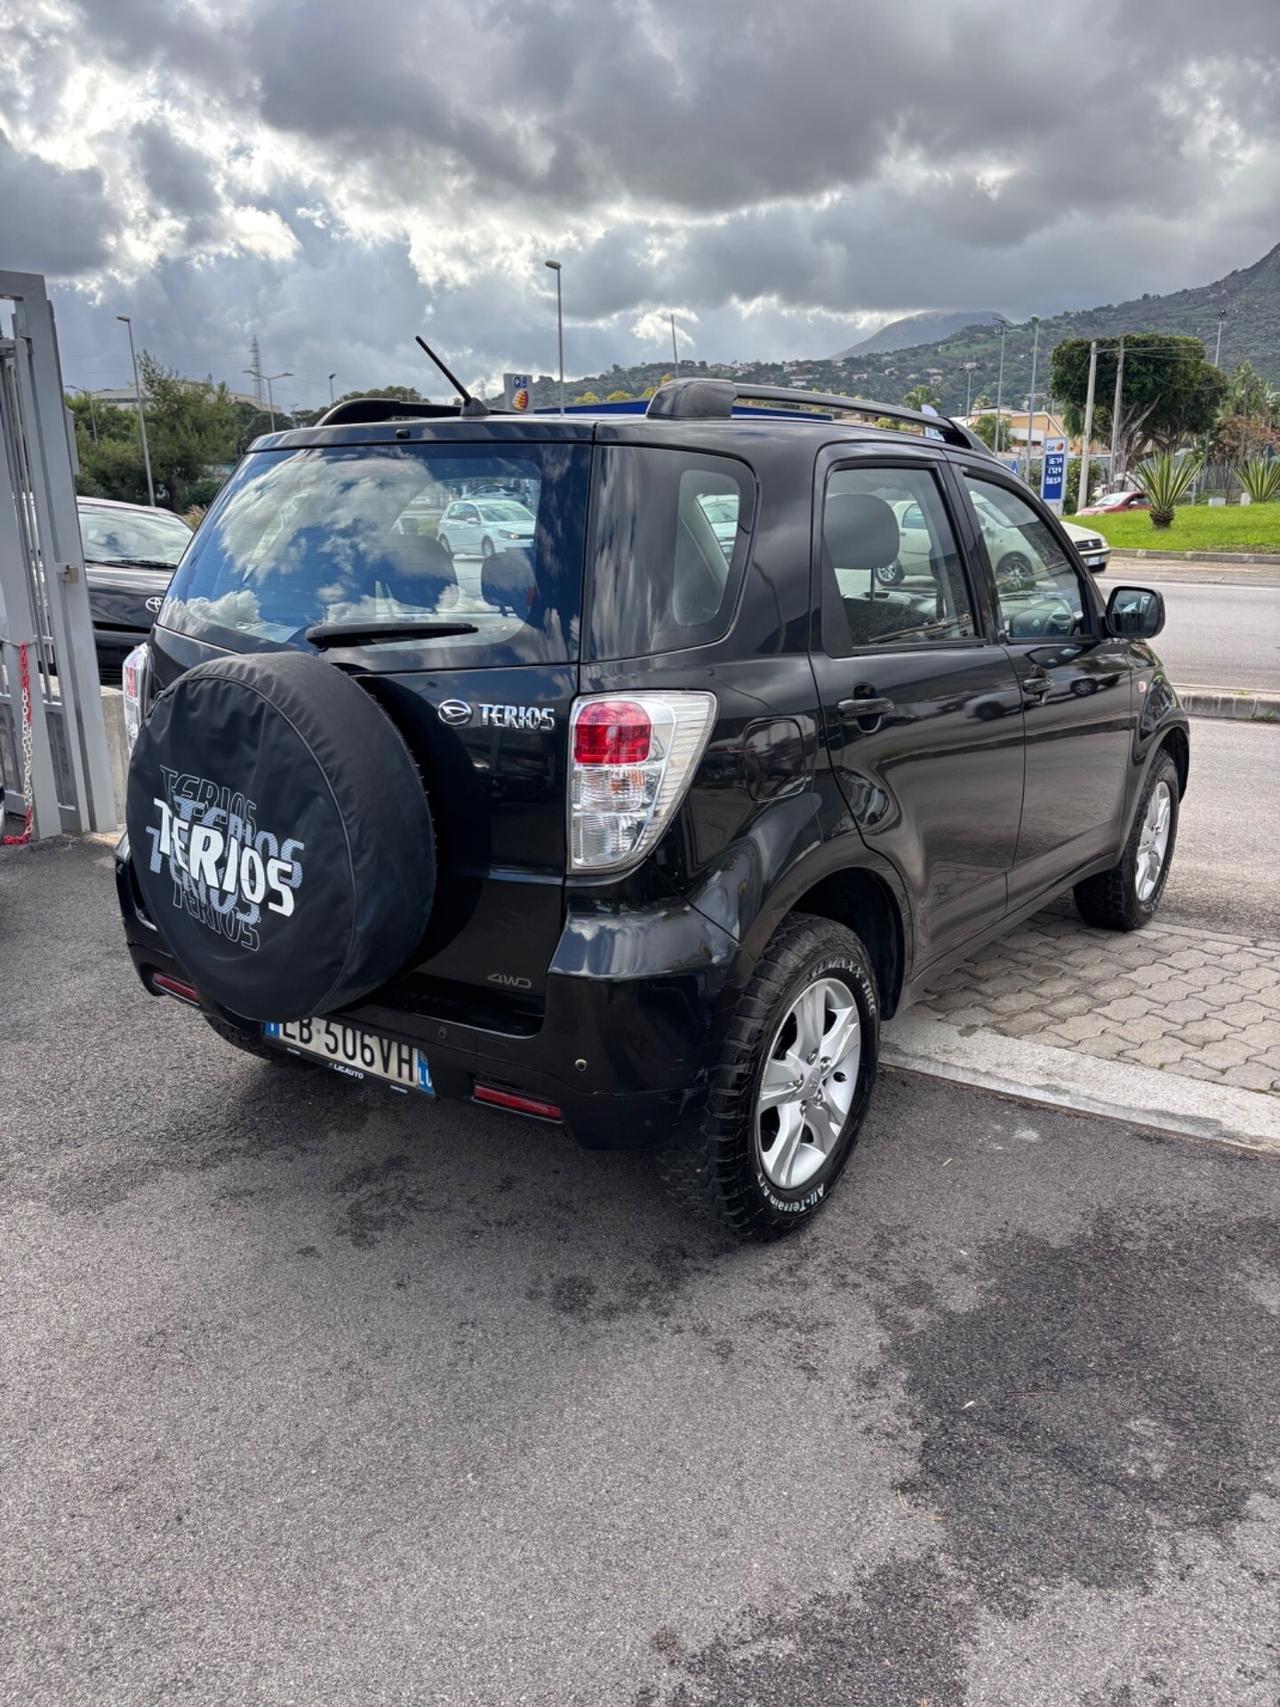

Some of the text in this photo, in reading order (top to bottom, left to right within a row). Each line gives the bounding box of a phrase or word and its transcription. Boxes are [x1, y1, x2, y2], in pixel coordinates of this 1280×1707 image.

[514, 376, 528, 388] Q8
[478, 703, 555, 731] TERIOS
[153, 797, 295, 918] TERIOS
[487, 972, 532, 989] 4WD
[770, 1183, 825, 1213] All-Terrain
